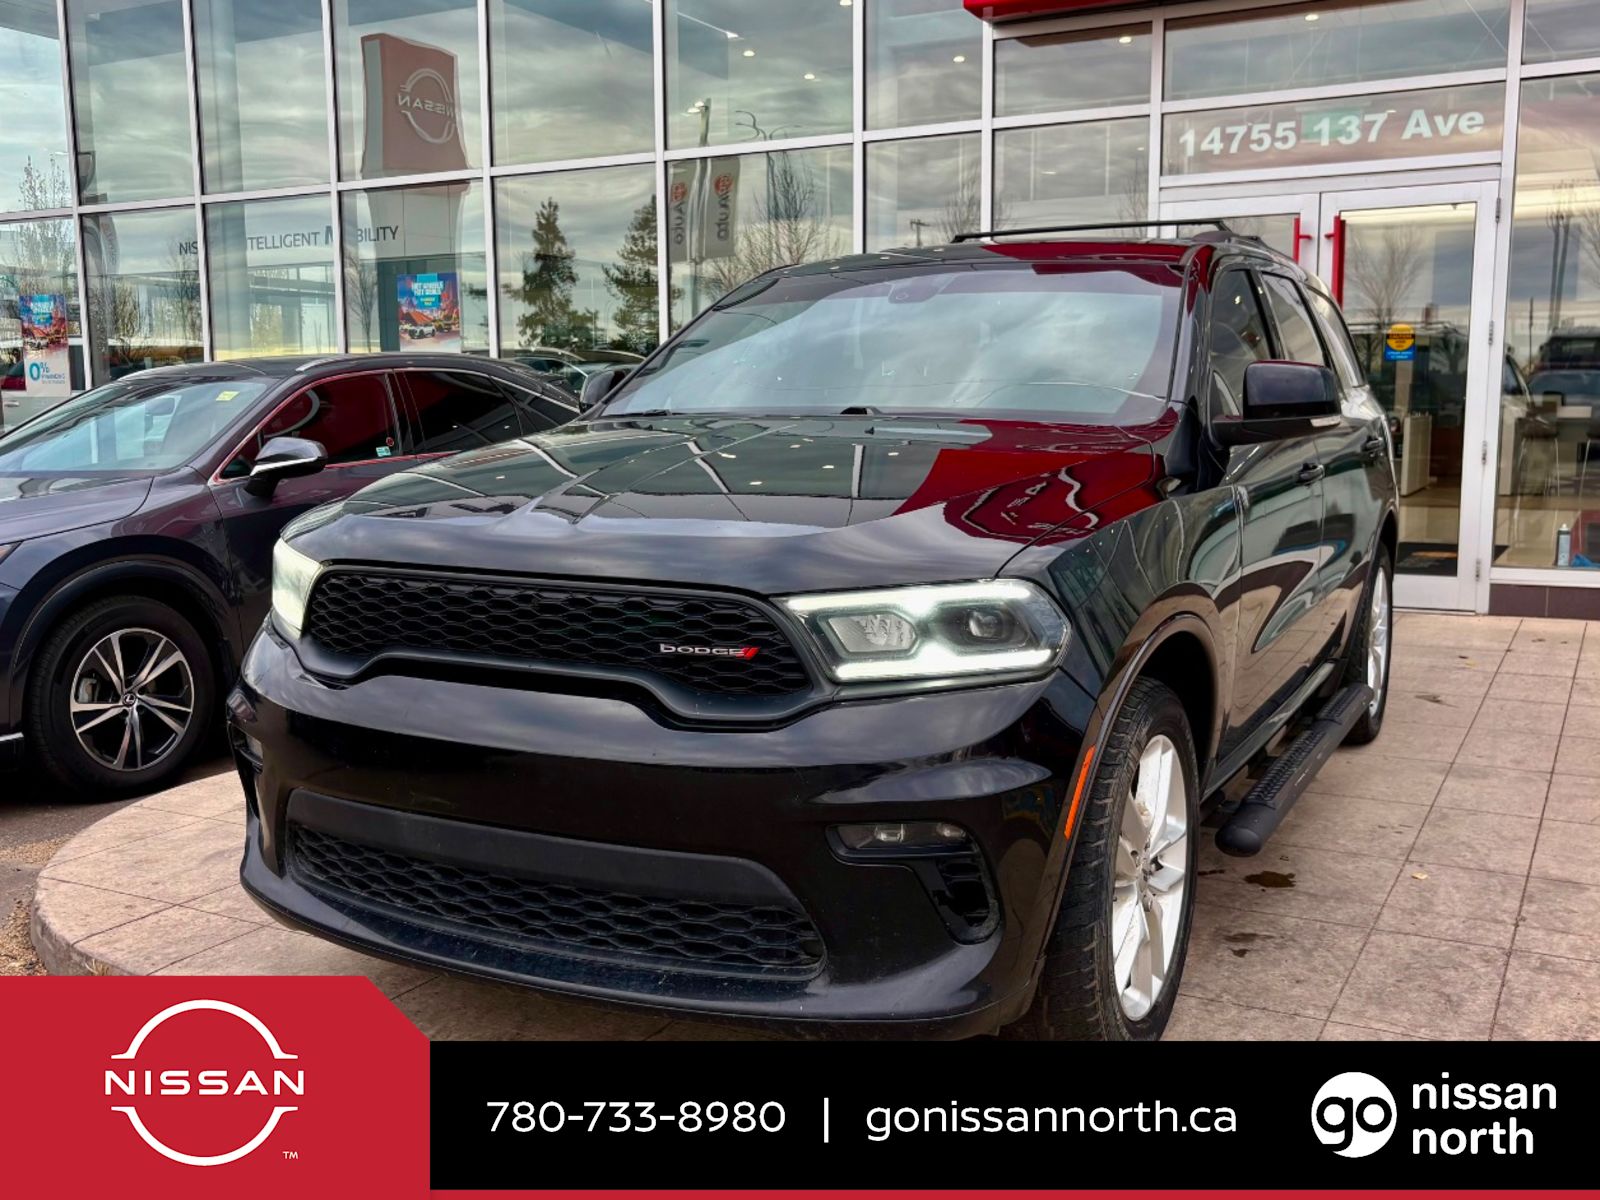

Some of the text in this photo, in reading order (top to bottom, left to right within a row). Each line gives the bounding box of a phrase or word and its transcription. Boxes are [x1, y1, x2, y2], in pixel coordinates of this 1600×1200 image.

[1179, 109, 1485, 157] 14755 137 Ave
[247, 231, 321, 250] TELLIGENT
[660, 643, 745, 657] DODGE
